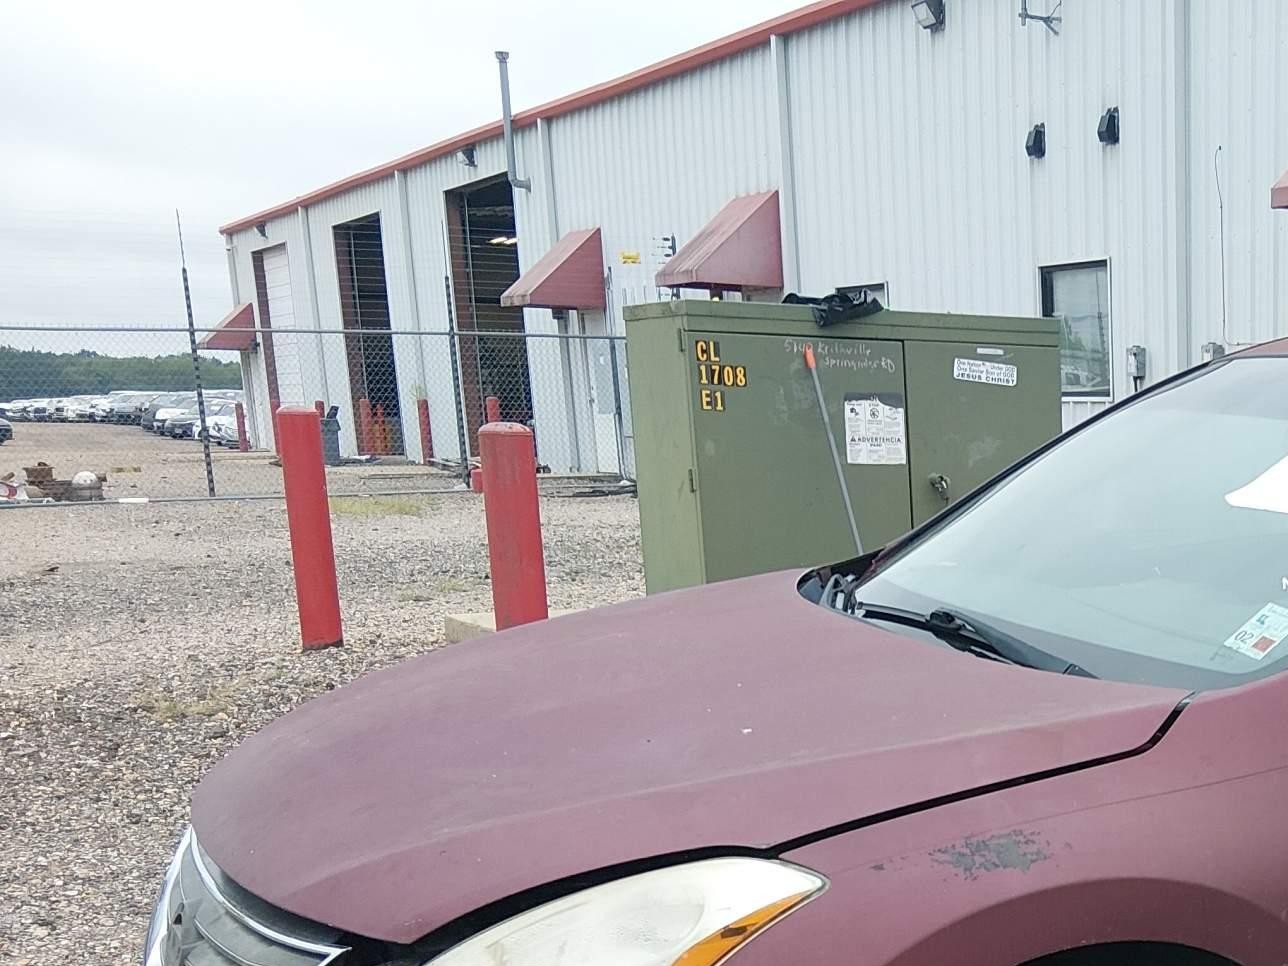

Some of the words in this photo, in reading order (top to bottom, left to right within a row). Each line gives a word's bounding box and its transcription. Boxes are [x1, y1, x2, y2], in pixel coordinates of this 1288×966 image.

[696, 340, 720, 362] CL
[699, 364, 746, 387] 1708
[956, 372, 982, 381] JESUS
[985, 375, 1015, 385] CHRIST
[701, 389, 724, 412] E1
[1234, 630, 1255, 642] 02
